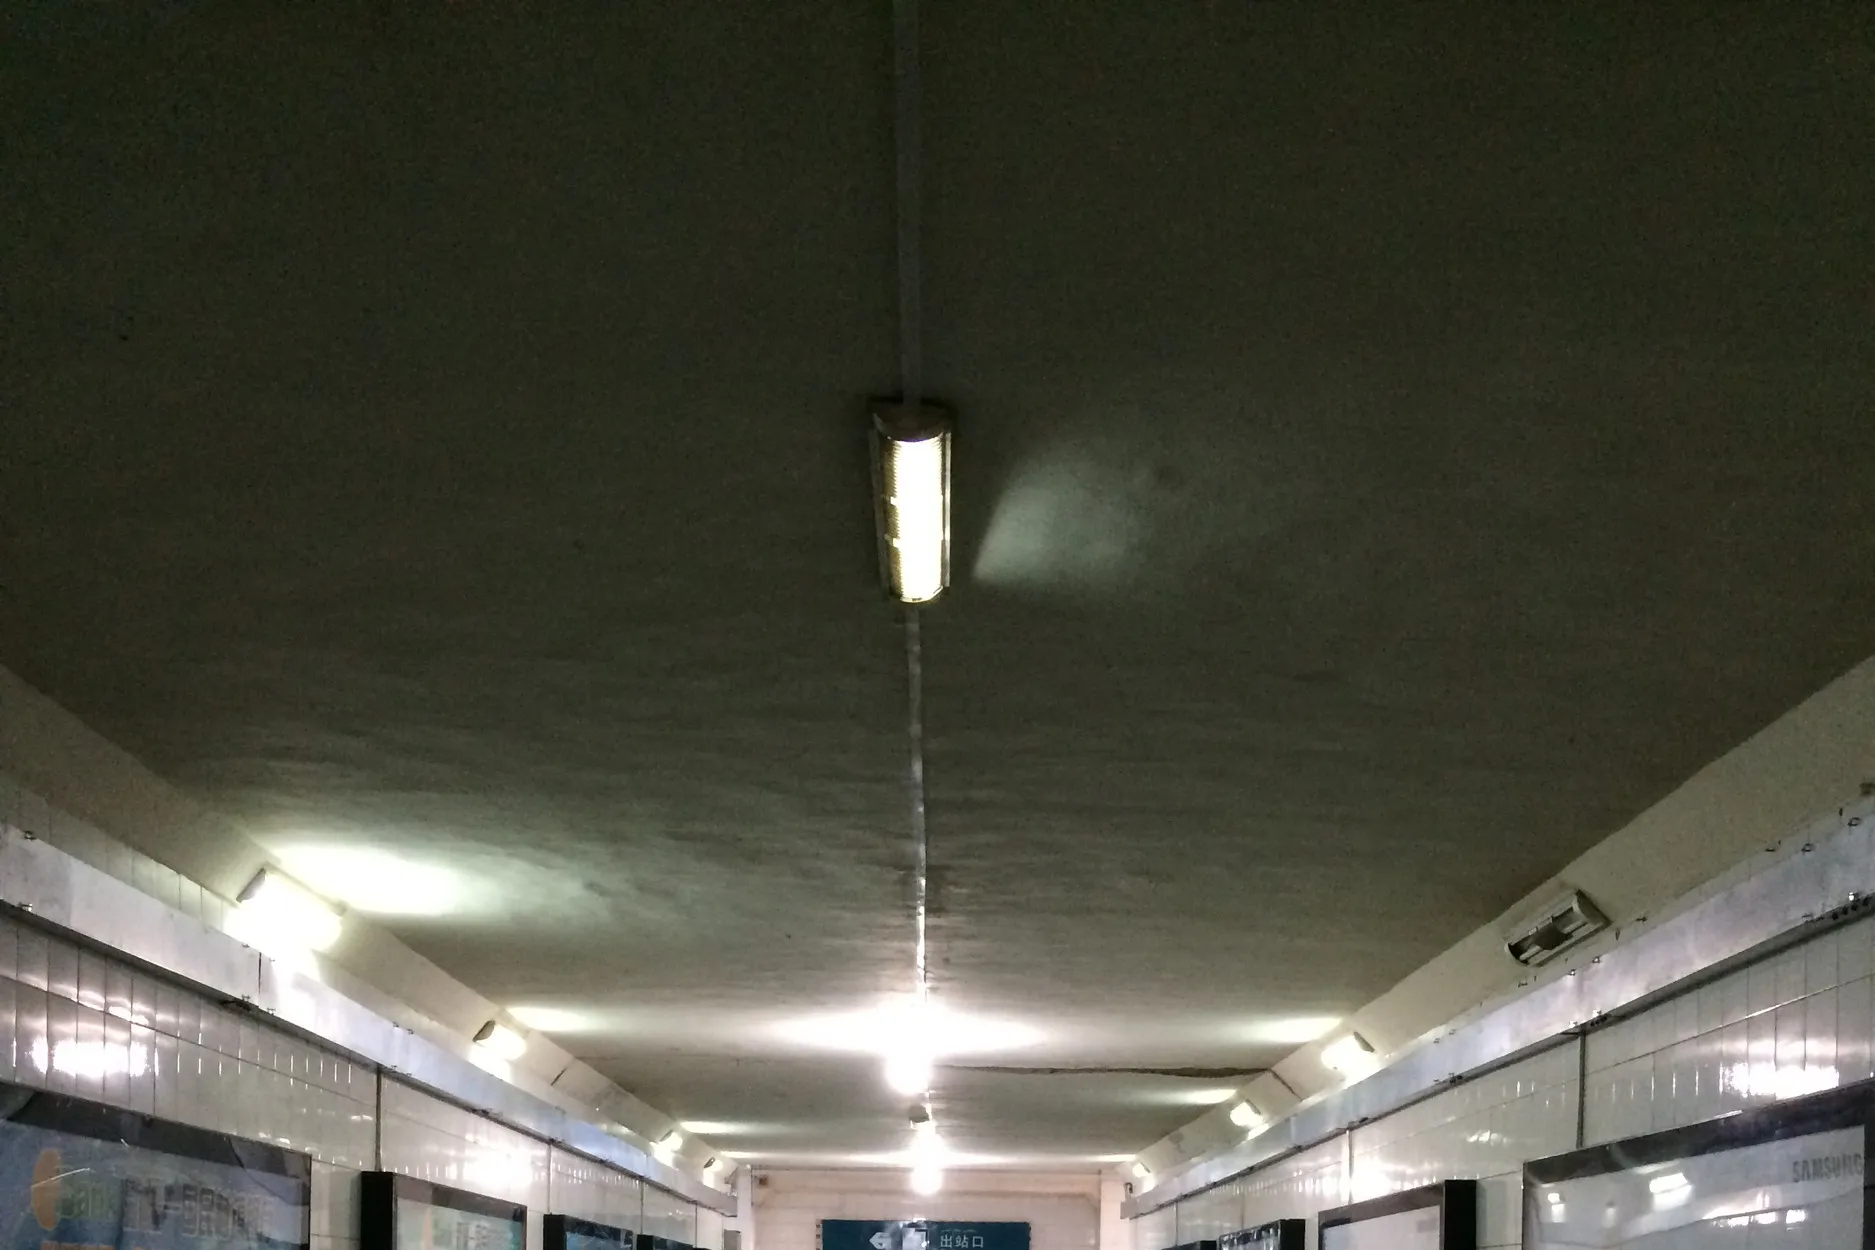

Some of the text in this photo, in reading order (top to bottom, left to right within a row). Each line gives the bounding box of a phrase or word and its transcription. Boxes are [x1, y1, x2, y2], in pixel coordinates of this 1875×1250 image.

[1792, 1152, 1864, 1183] SAMSUNG
[940, 1234, 984, 1249] 出站口
